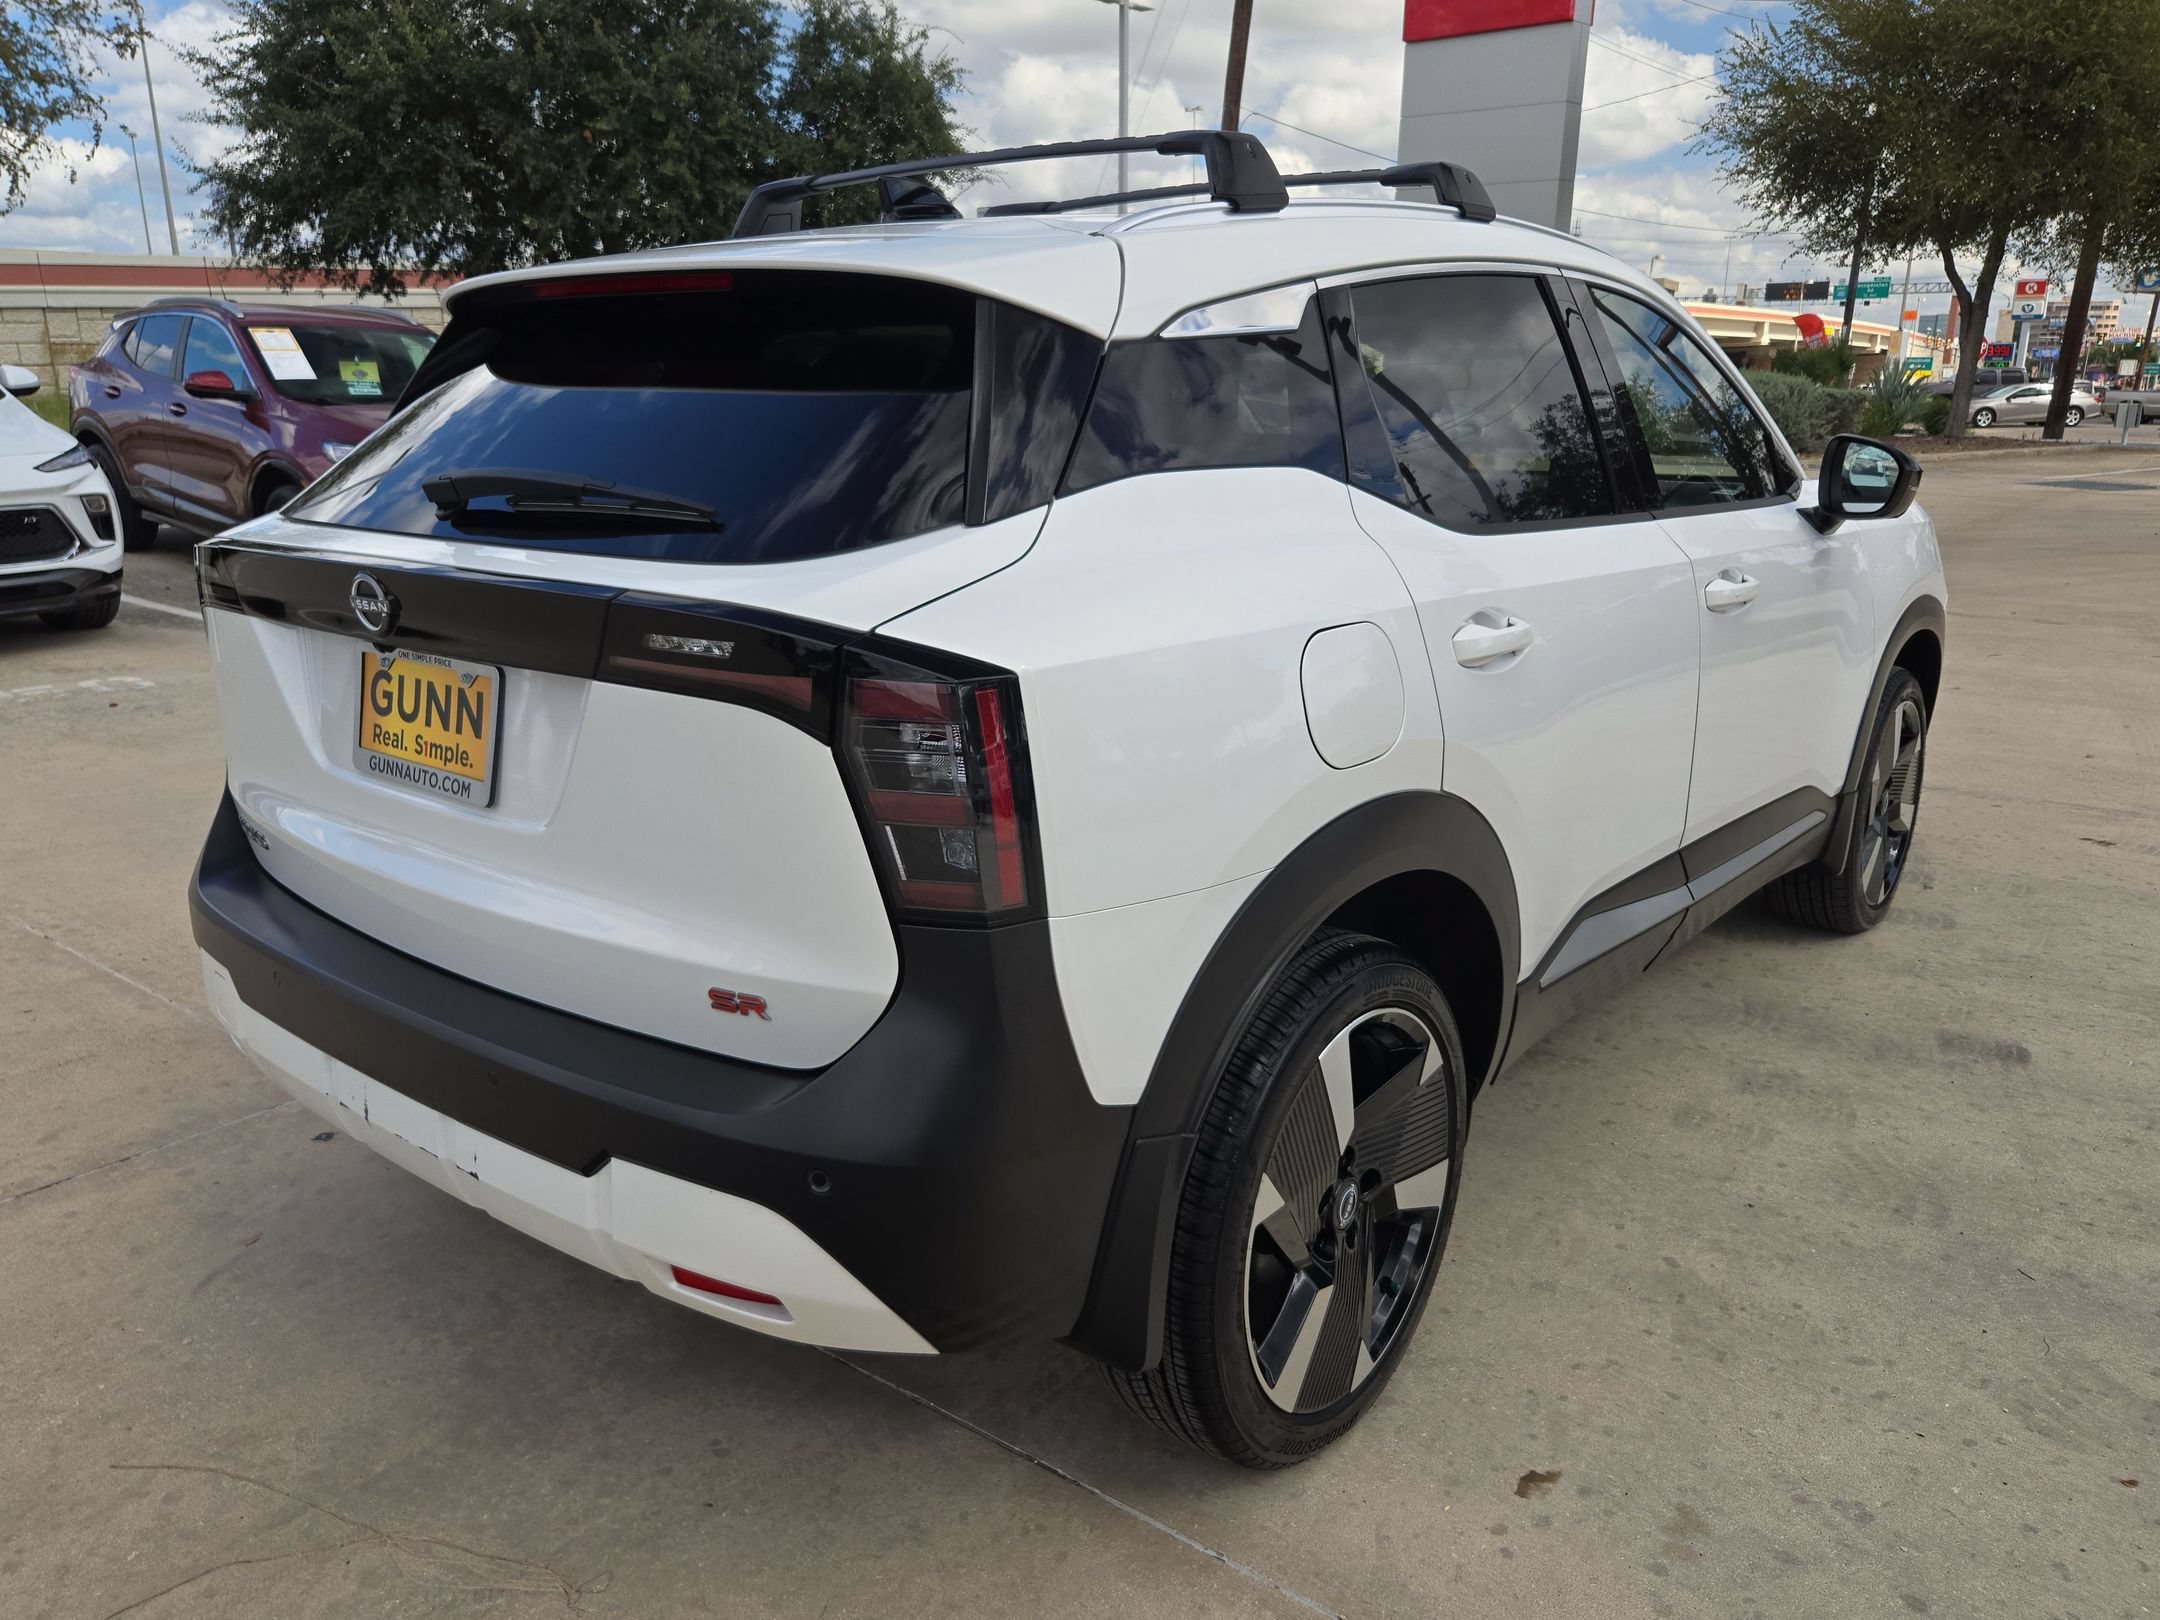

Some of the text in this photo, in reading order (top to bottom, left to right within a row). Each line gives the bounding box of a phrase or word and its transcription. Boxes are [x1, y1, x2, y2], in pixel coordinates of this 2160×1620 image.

[398, 650, 409, 659] ONE
[370, 669, 484, 740] GUNN
[373, 723, 408, 752] Real.
[369, 755, 472, 799] GUNNAUTO.COM
[708, 986, 772, 1021] SR
